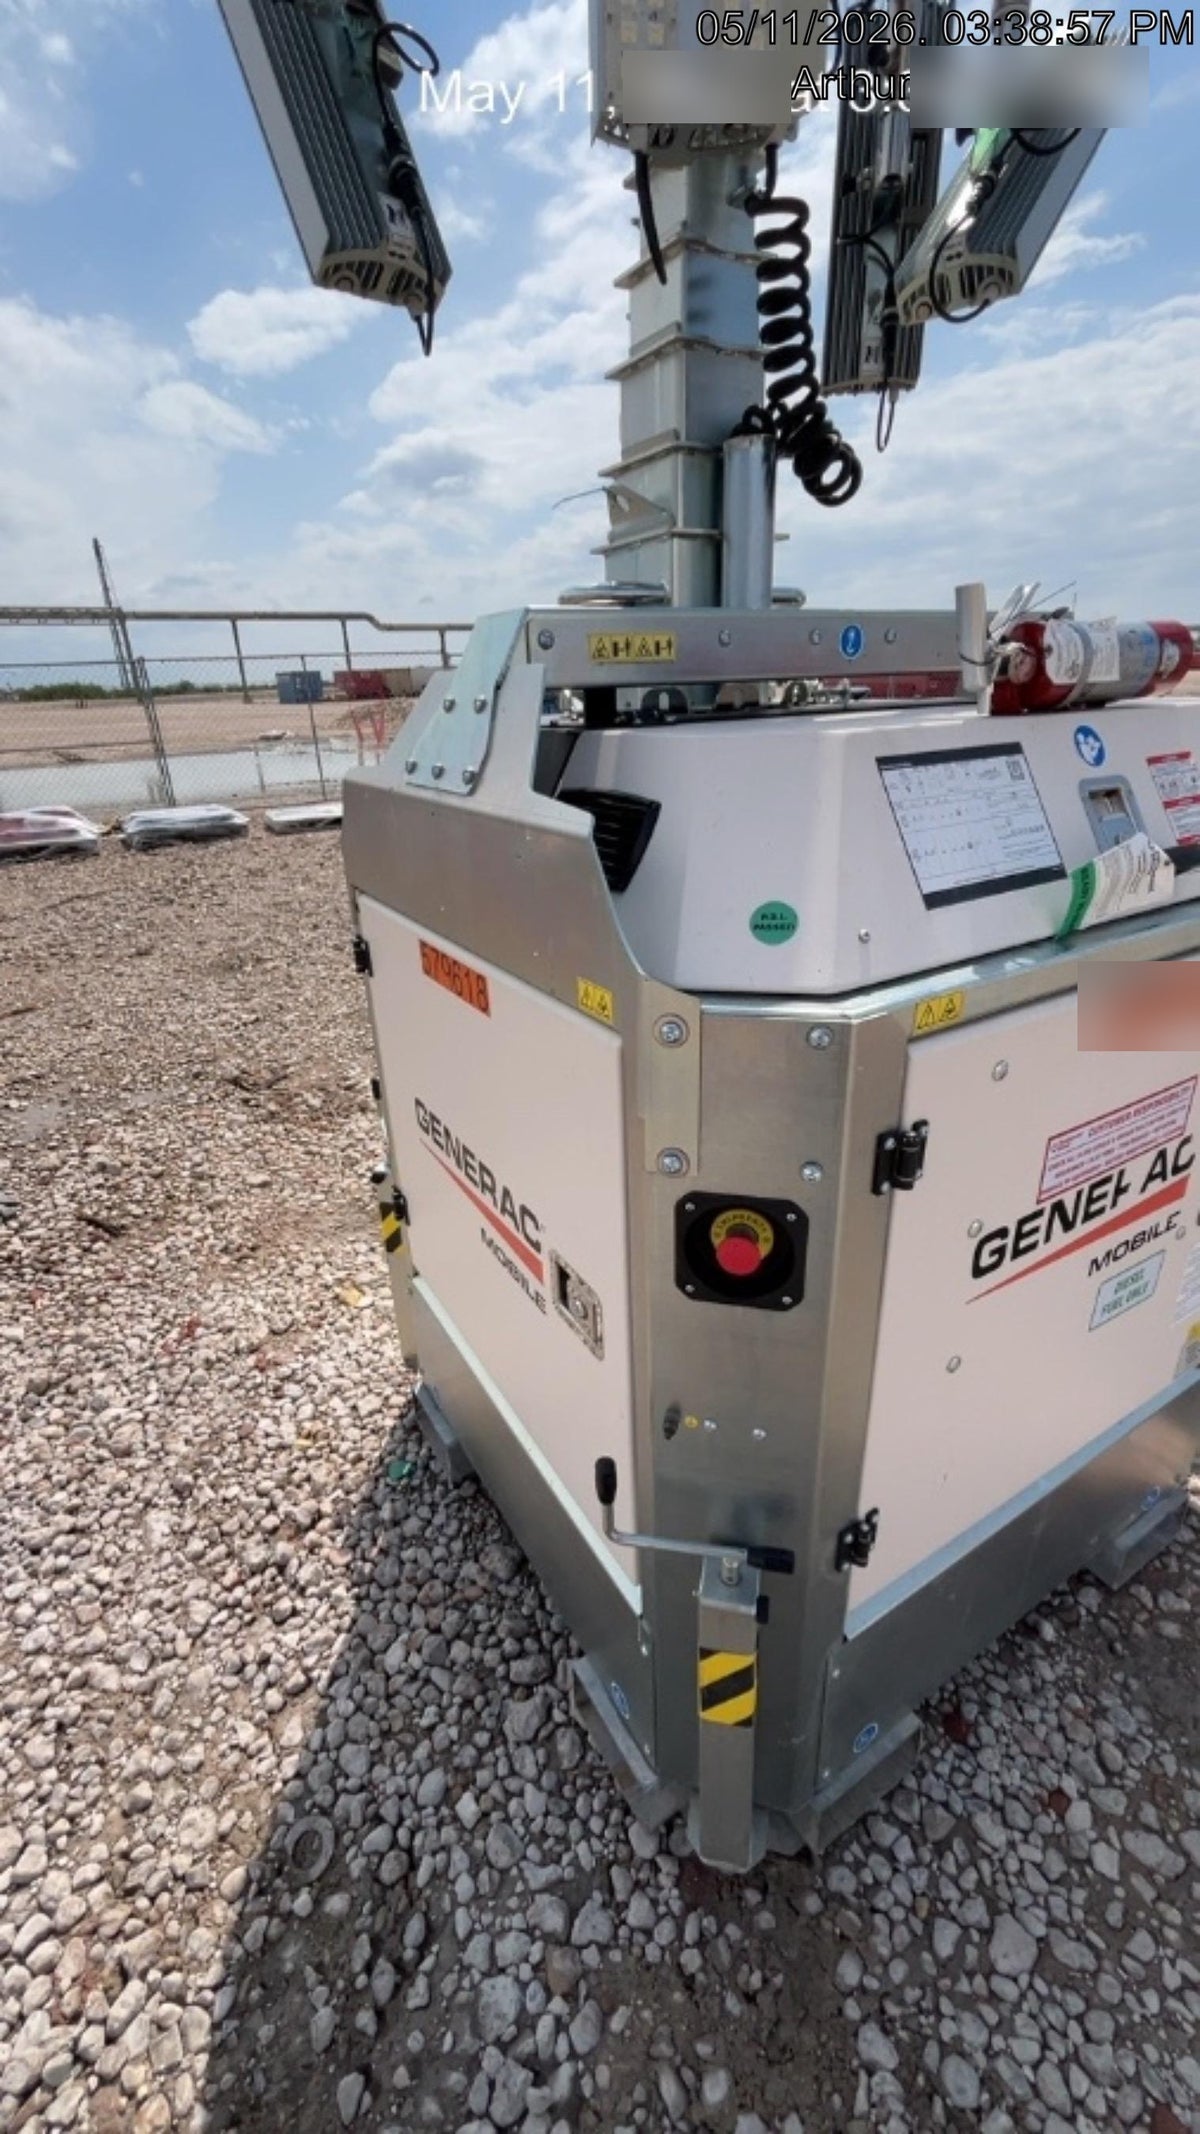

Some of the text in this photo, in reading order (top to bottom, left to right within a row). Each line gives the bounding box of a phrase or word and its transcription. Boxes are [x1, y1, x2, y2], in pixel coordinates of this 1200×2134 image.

[415, 1097, 541, 1255] GENERAC
[481, 1227, 546, 1315] MOBILE
[1088, 1210, 1181, 1276] MOBILE
